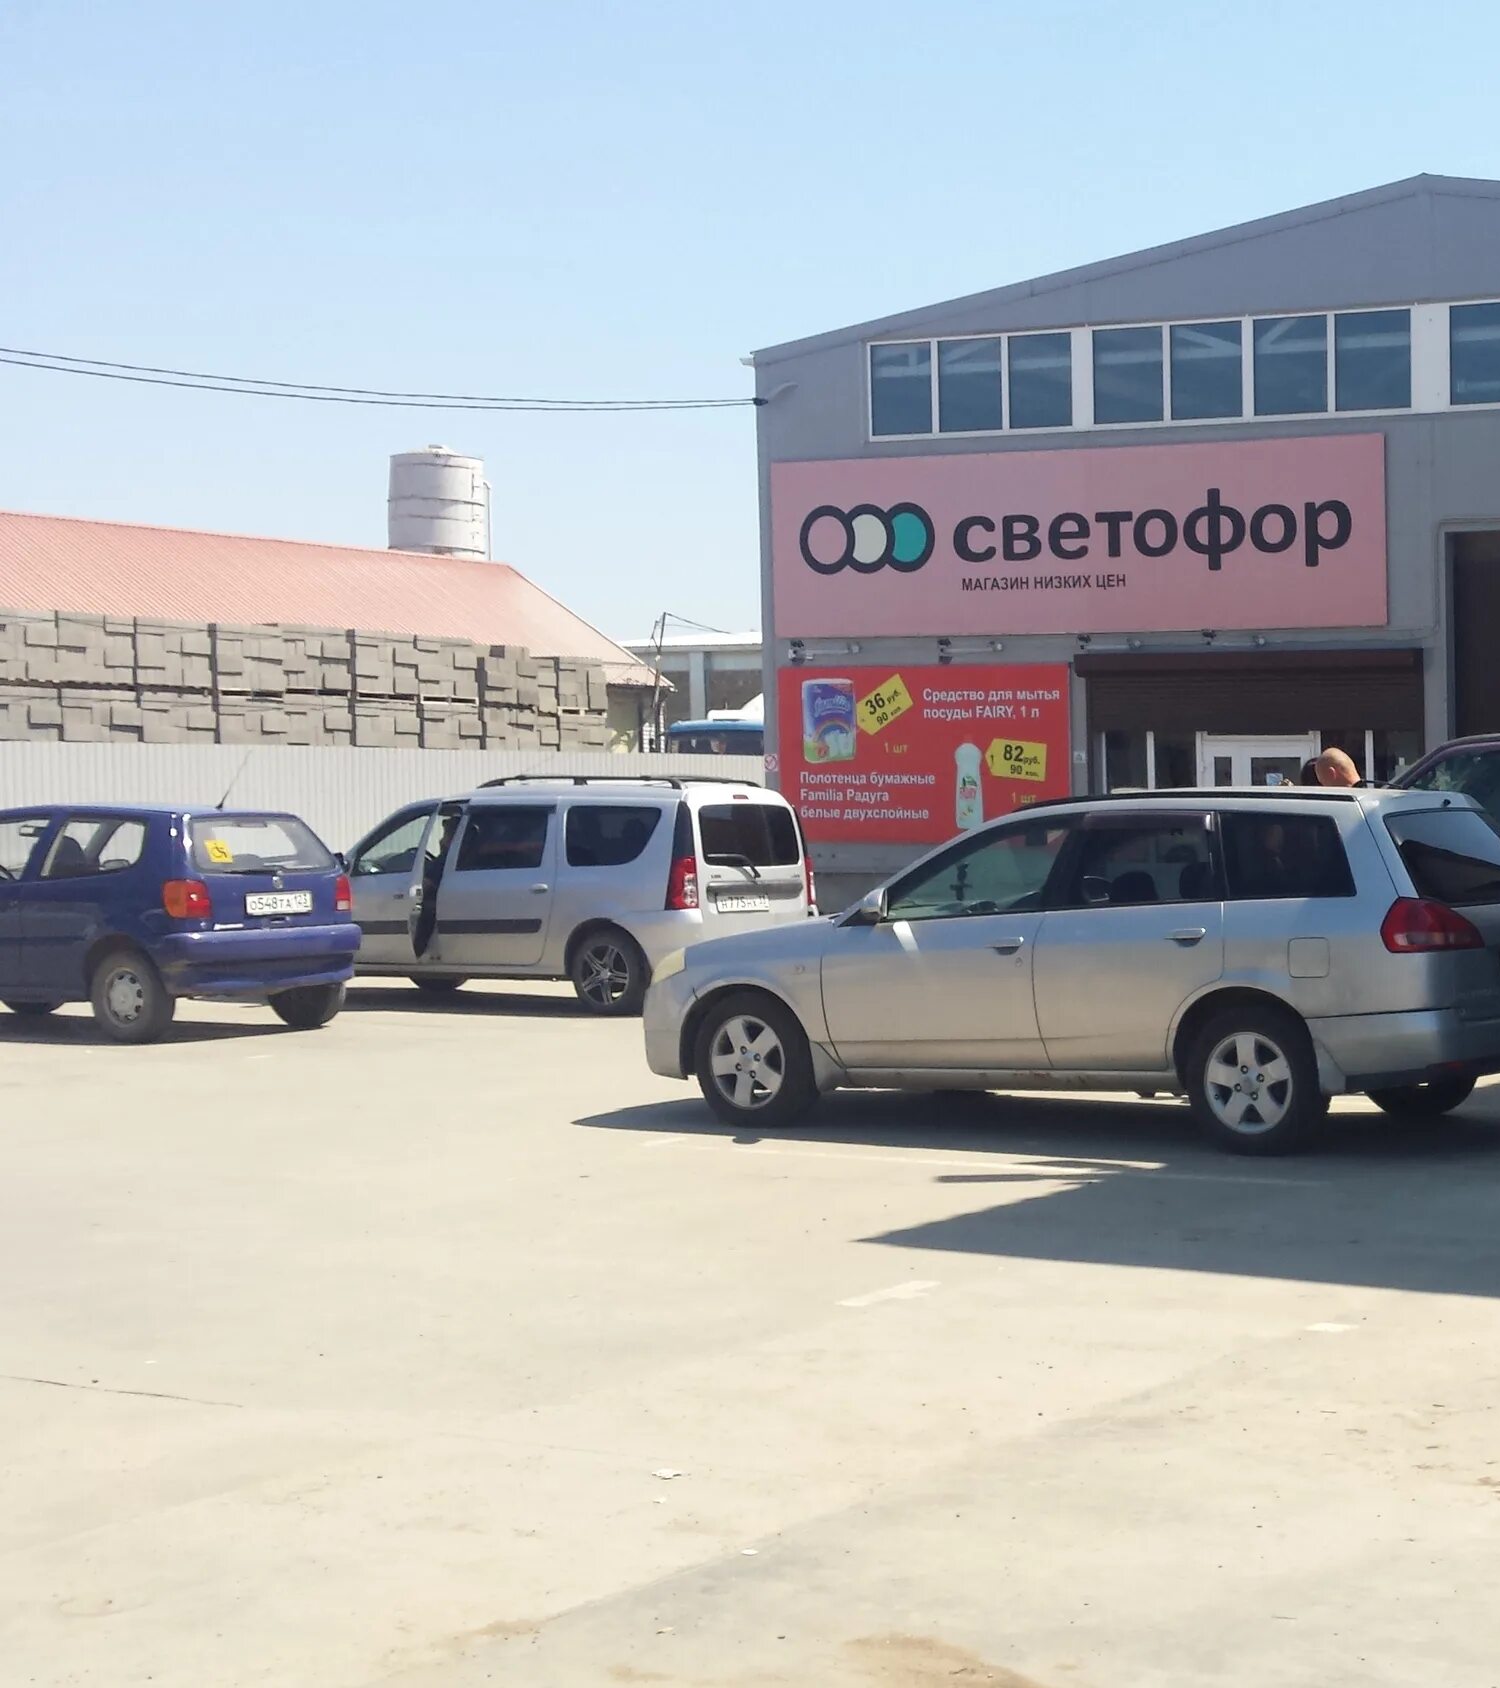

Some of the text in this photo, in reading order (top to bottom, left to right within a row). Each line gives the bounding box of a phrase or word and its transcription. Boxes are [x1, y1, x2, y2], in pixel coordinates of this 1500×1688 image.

[953, 488, 1353, 571] светофор
[961, 574, 1127, 591] МАГАЗИН НИЗКИХ ЦЕН
[923, 688, 1060, 703] Средство для мытья
[865, 693, 886, 716] 36
[876, 712, 889, 726] 90
[923, 708, 972, 721] посуды
[975, 705, 1016, 719] FAIRY,
[1020, 705, 1026, 718] 1
[884, 741, 889, 754] 1
[1003, 744, 1024, 762] 82
[1010, 764, 1023, 776] 90
[800, 771, 936, 787] Полотенца бумажные
[800, 788, 889, 804] Familia Радуга
[1012, 791, 1016, 804] 1
[800, 805, 929, 821] белые двухслойные
